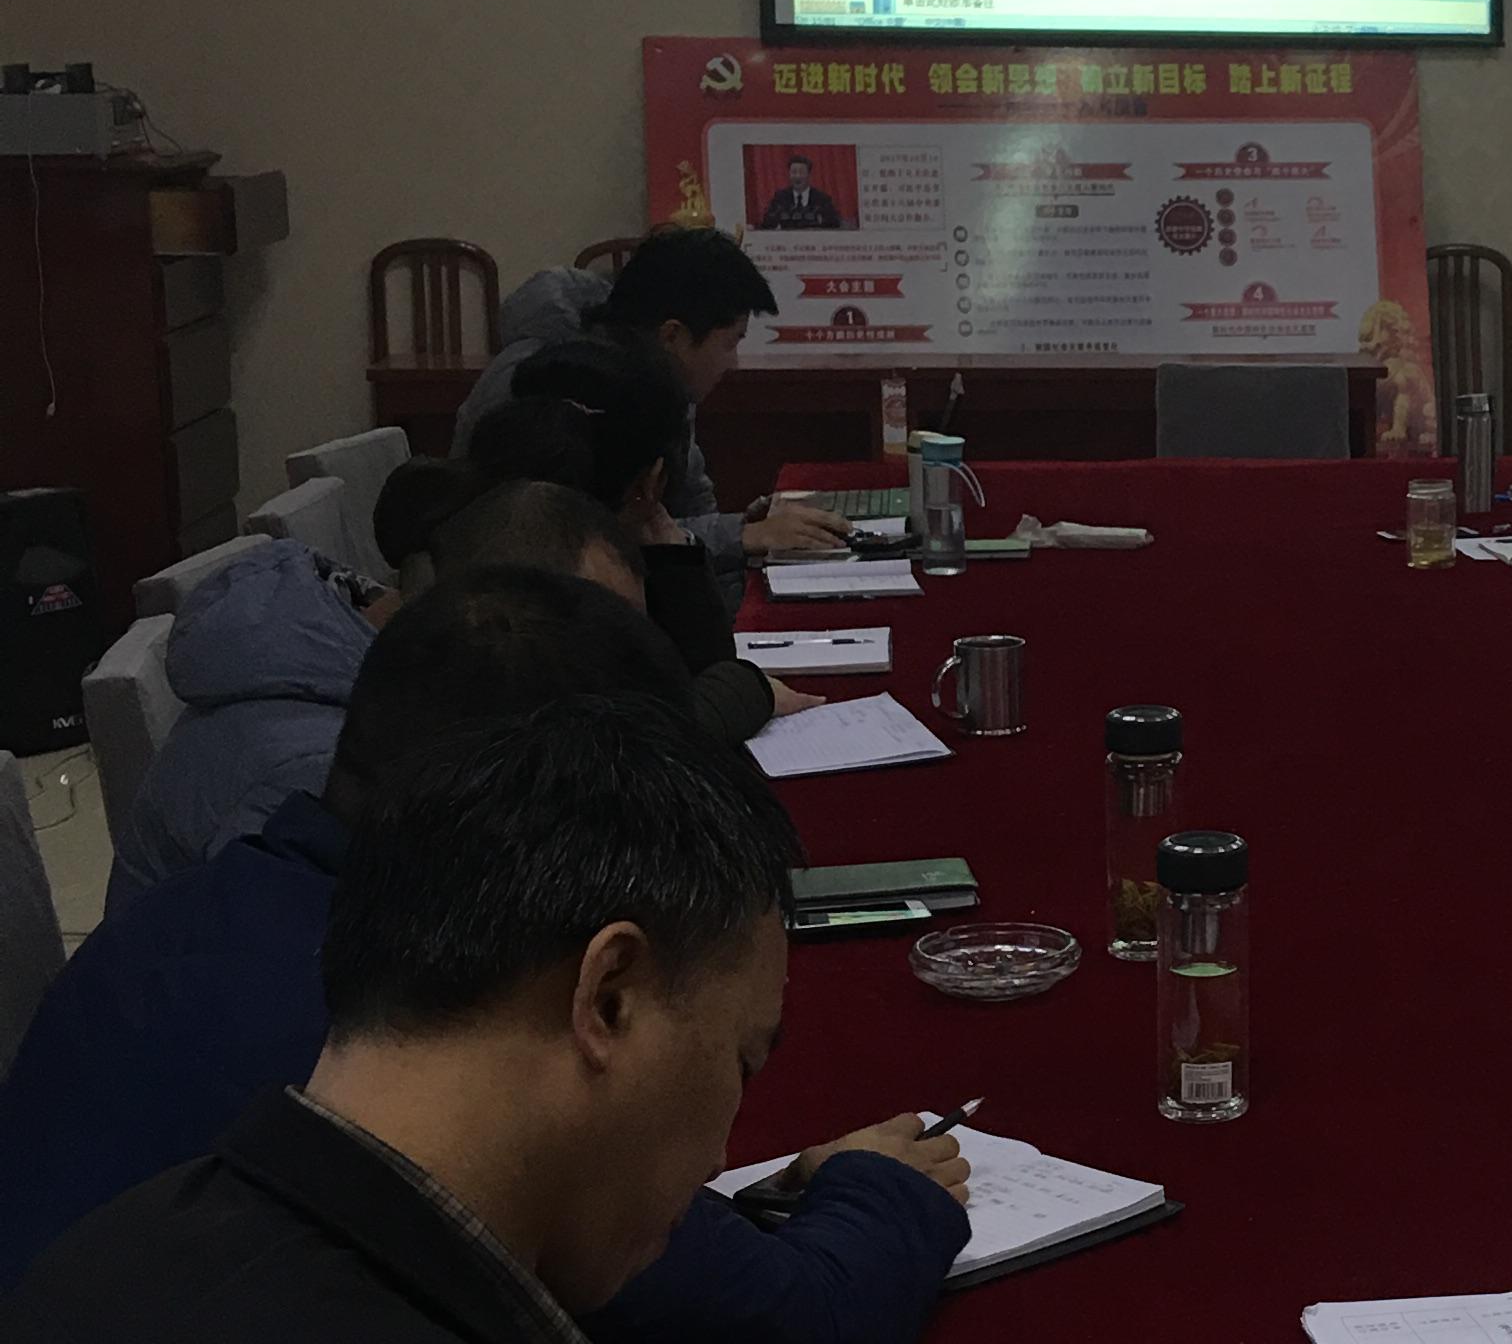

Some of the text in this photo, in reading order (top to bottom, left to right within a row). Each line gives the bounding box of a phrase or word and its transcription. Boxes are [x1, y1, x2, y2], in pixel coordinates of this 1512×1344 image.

[773, 62, 907, 95] 迈进新时代
[928, 62, 1057, 96] 领会新思想
[1229, 62, 1353, 95] 踏上新征程
[1247, 147, 1258, 162] 3
[825, 280, 876, 294] 大会主题
[1253, 287, 1265, 301] 4
[845, 311, 855, 325] 1
